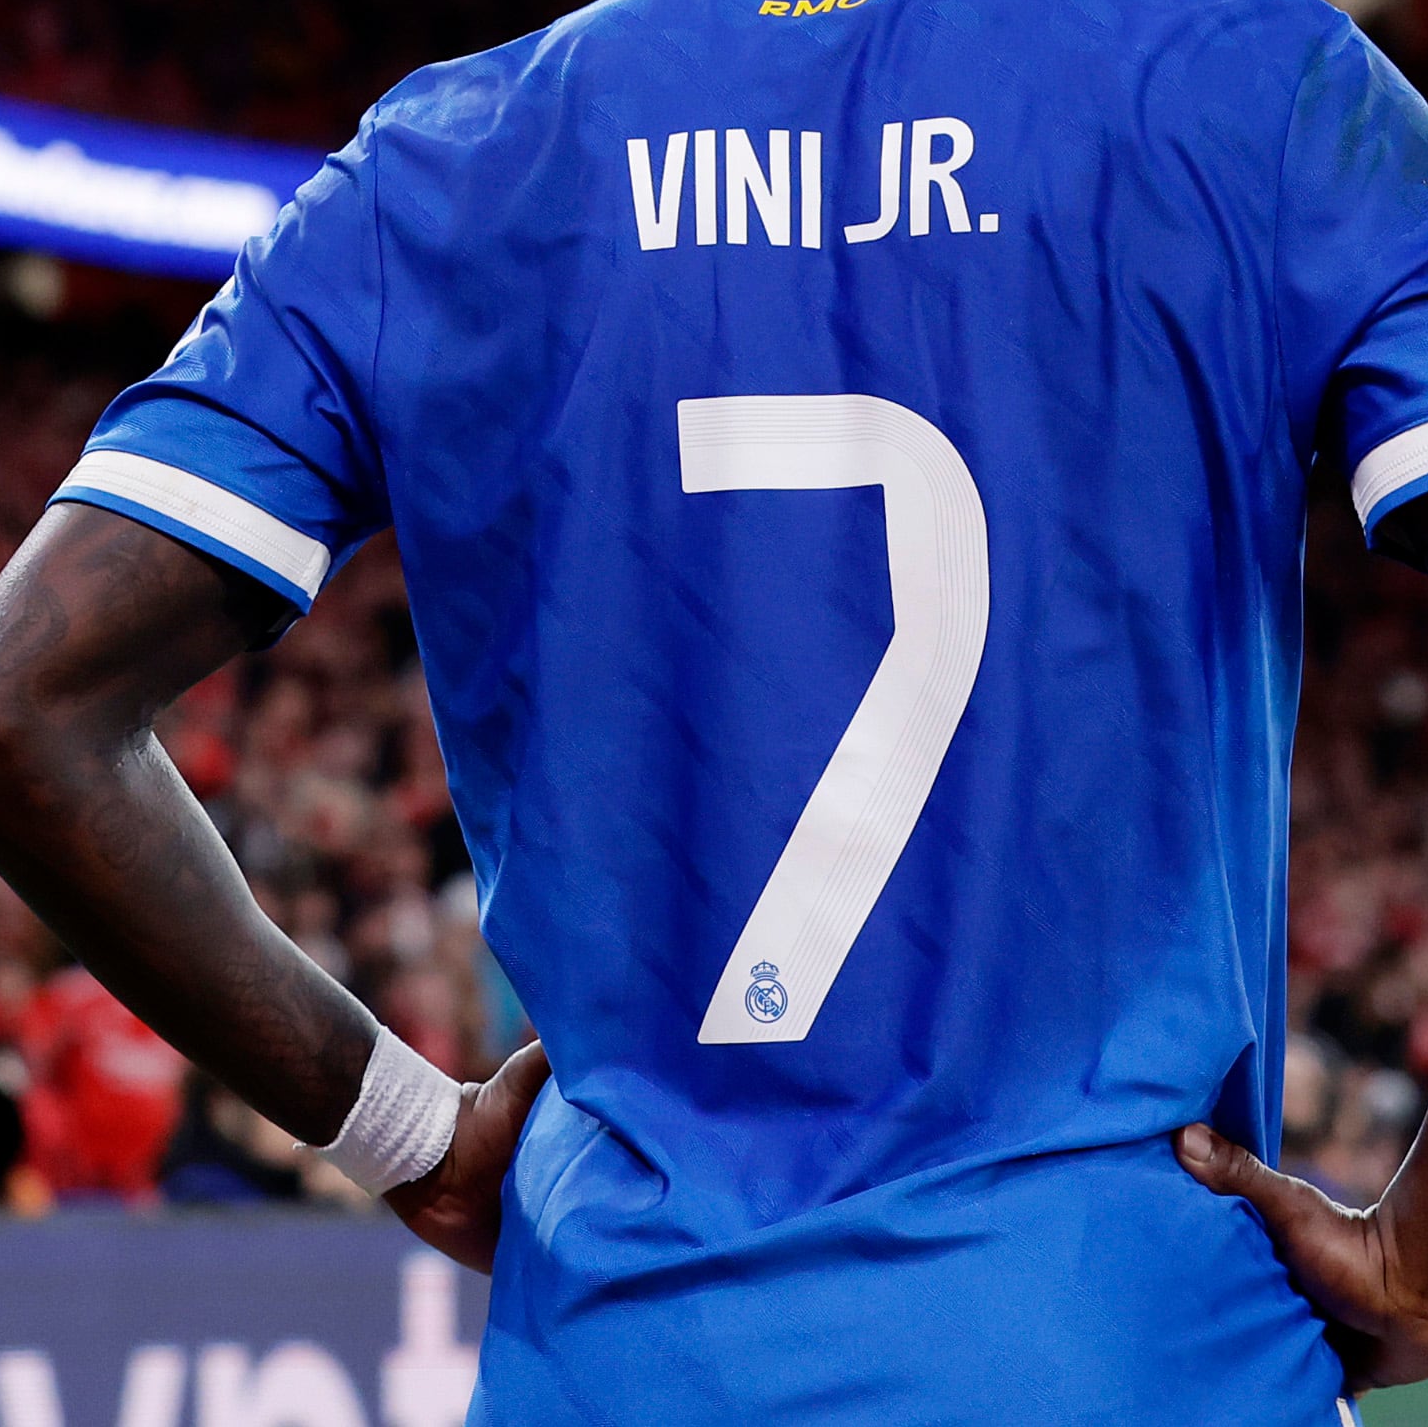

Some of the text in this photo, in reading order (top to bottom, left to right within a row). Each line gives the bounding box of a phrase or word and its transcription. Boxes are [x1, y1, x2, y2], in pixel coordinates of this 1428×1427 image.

[626, 116, 1000, 252] VINI JR.
[676, 393, 991, 1045] 7
